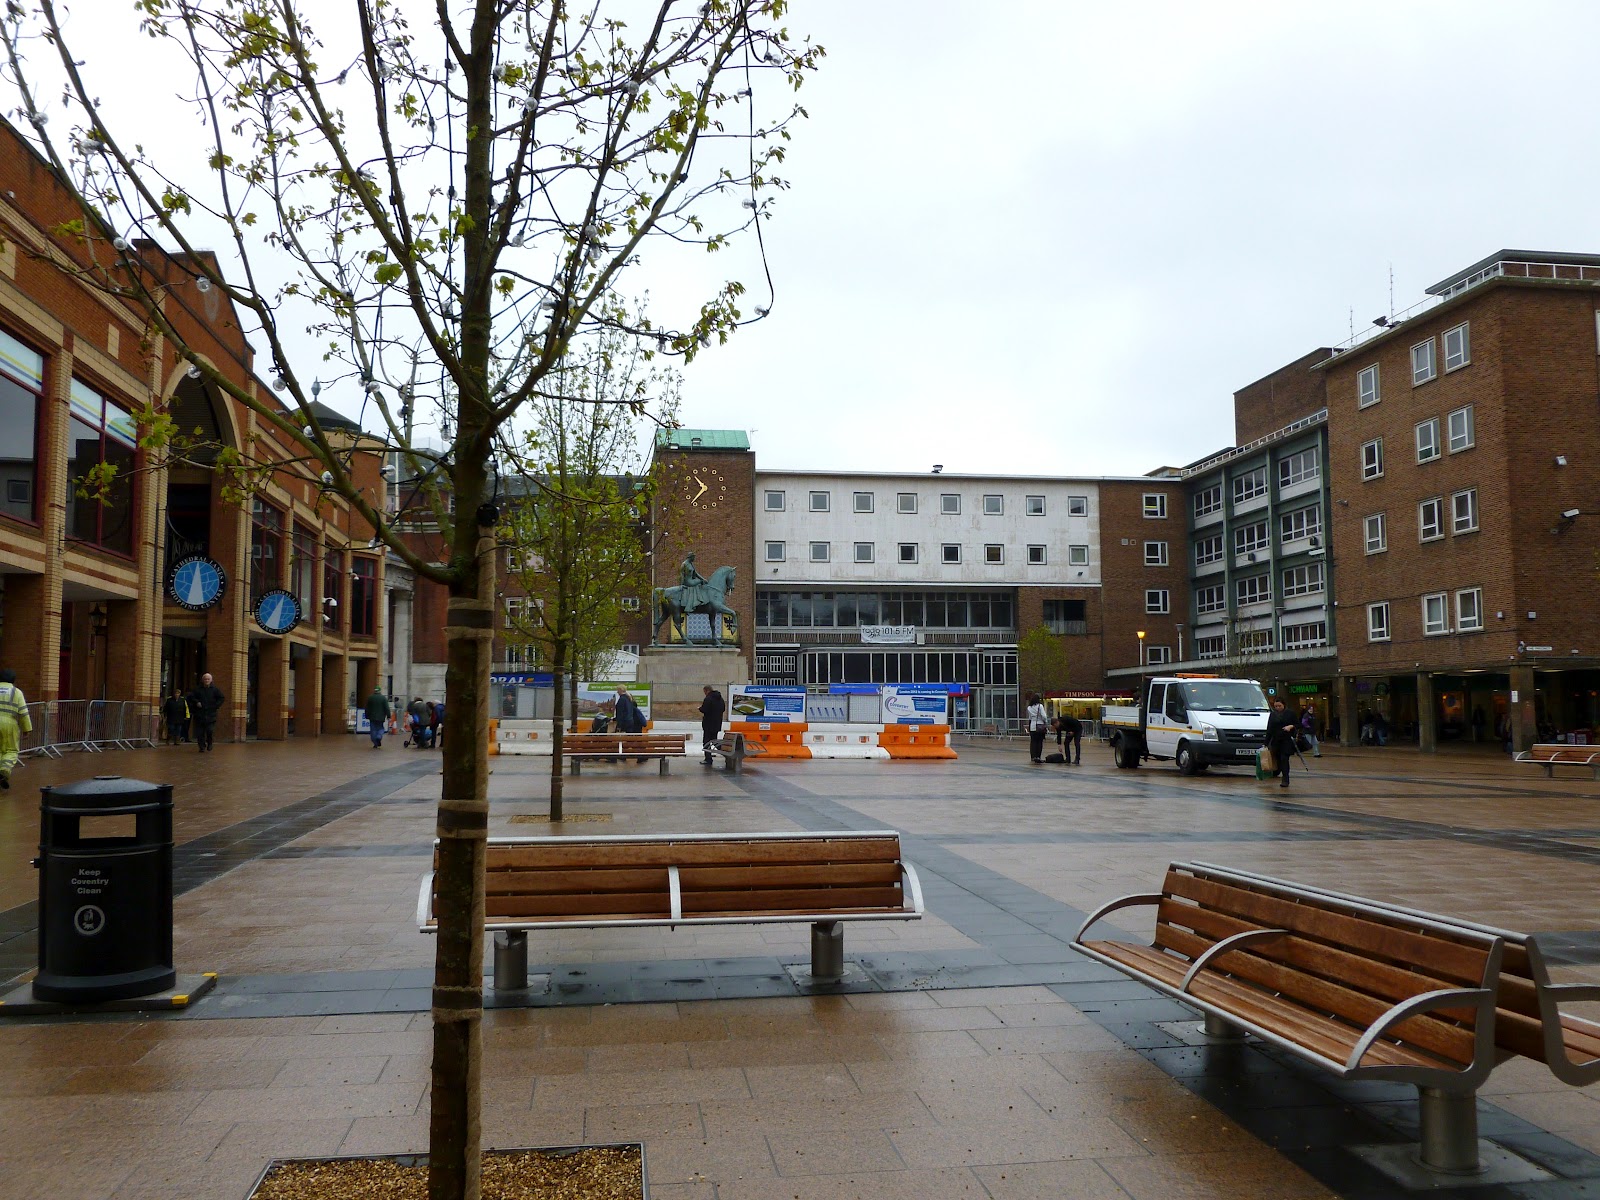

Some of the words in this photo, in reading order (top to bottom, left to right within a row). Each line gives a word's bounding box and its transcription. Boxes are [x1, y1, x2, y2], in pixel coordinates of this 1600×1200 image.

[170, 556, 207, 577] CATHEDRAL
[209, 560, 224, 579] LANES
[170, 586, 199, 610] SHOPPING
[200, 588, 224, 609] CENTRE
[490, 676, 525, 686] ORAL
[78, 868, 101, 876] Keep
[71, 878, 109, 886] Coventry
